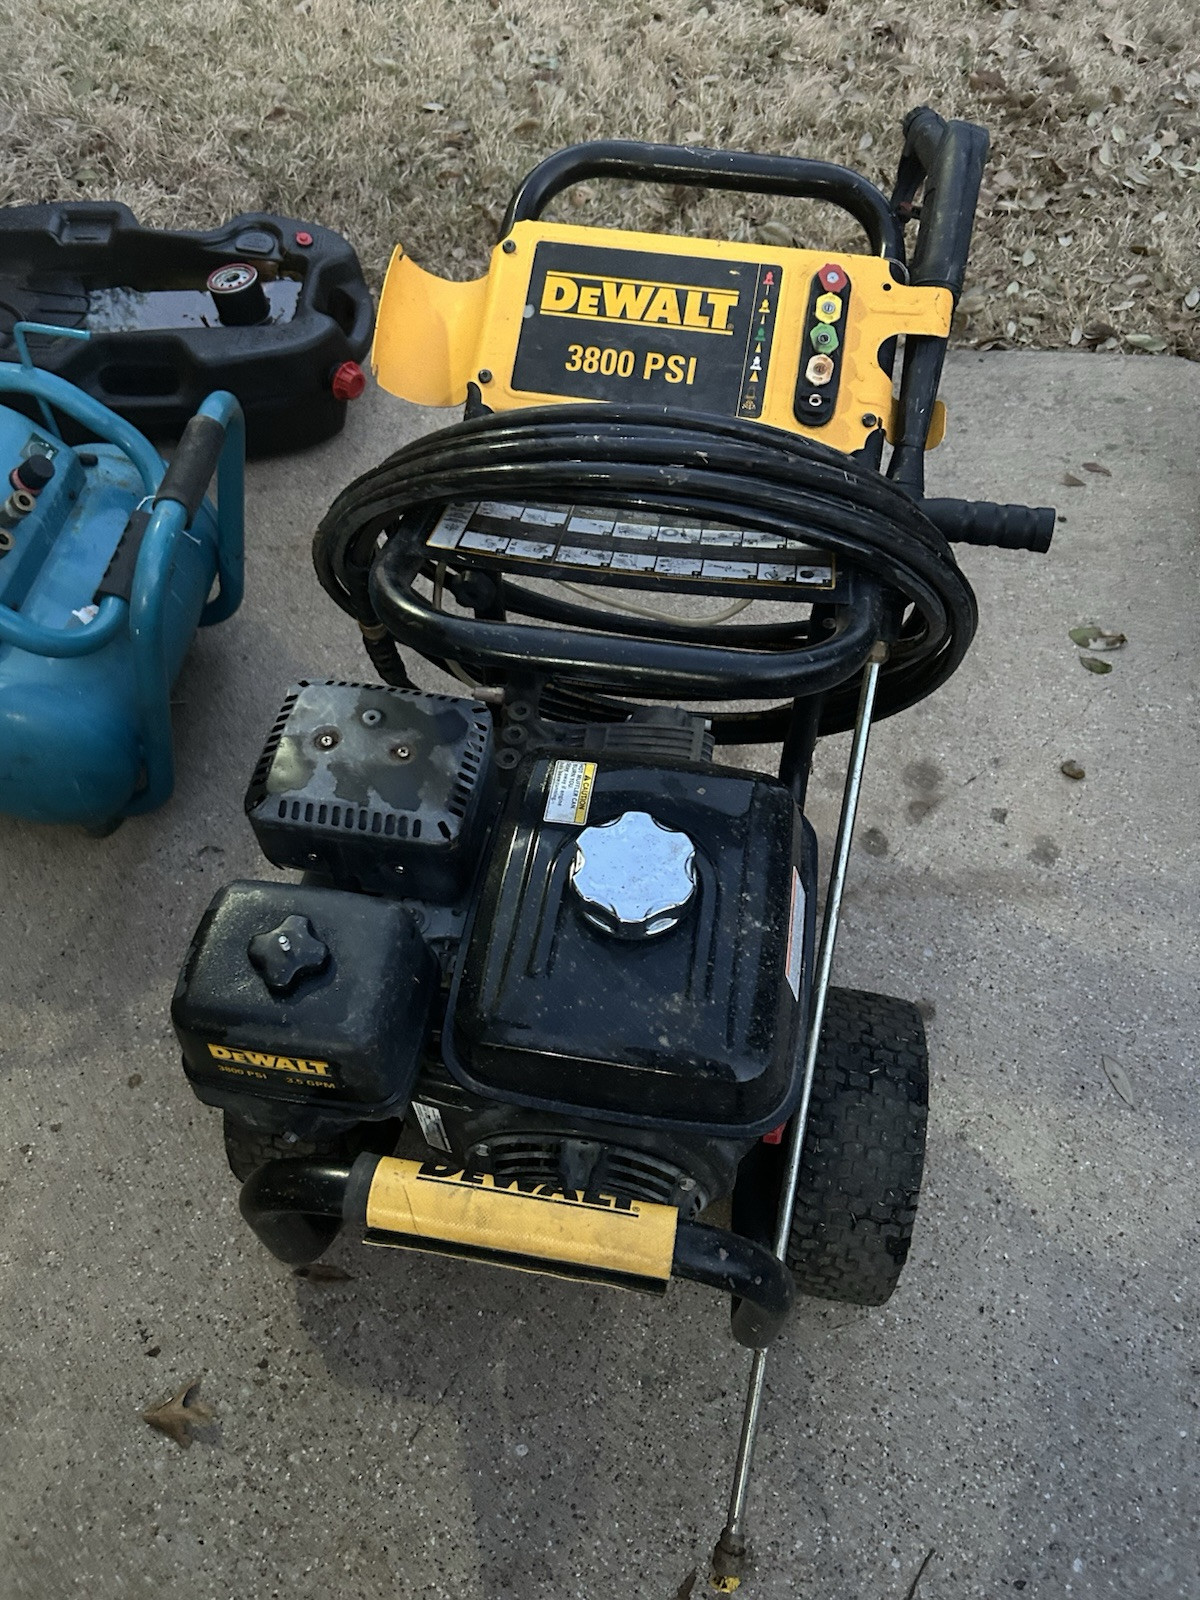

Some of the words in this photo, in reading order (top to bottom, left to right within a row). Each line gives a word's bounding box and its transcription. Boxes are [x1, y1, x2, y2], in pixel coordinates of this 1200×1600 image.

[565, 344, 635, 378] 3800
[643, 352, 697, 385] PSI
[573, 774, 581, 797] MUFFLER
[579, 782, 589, 810] CAUTION
[246, 1070, 268, 1079] PSI
